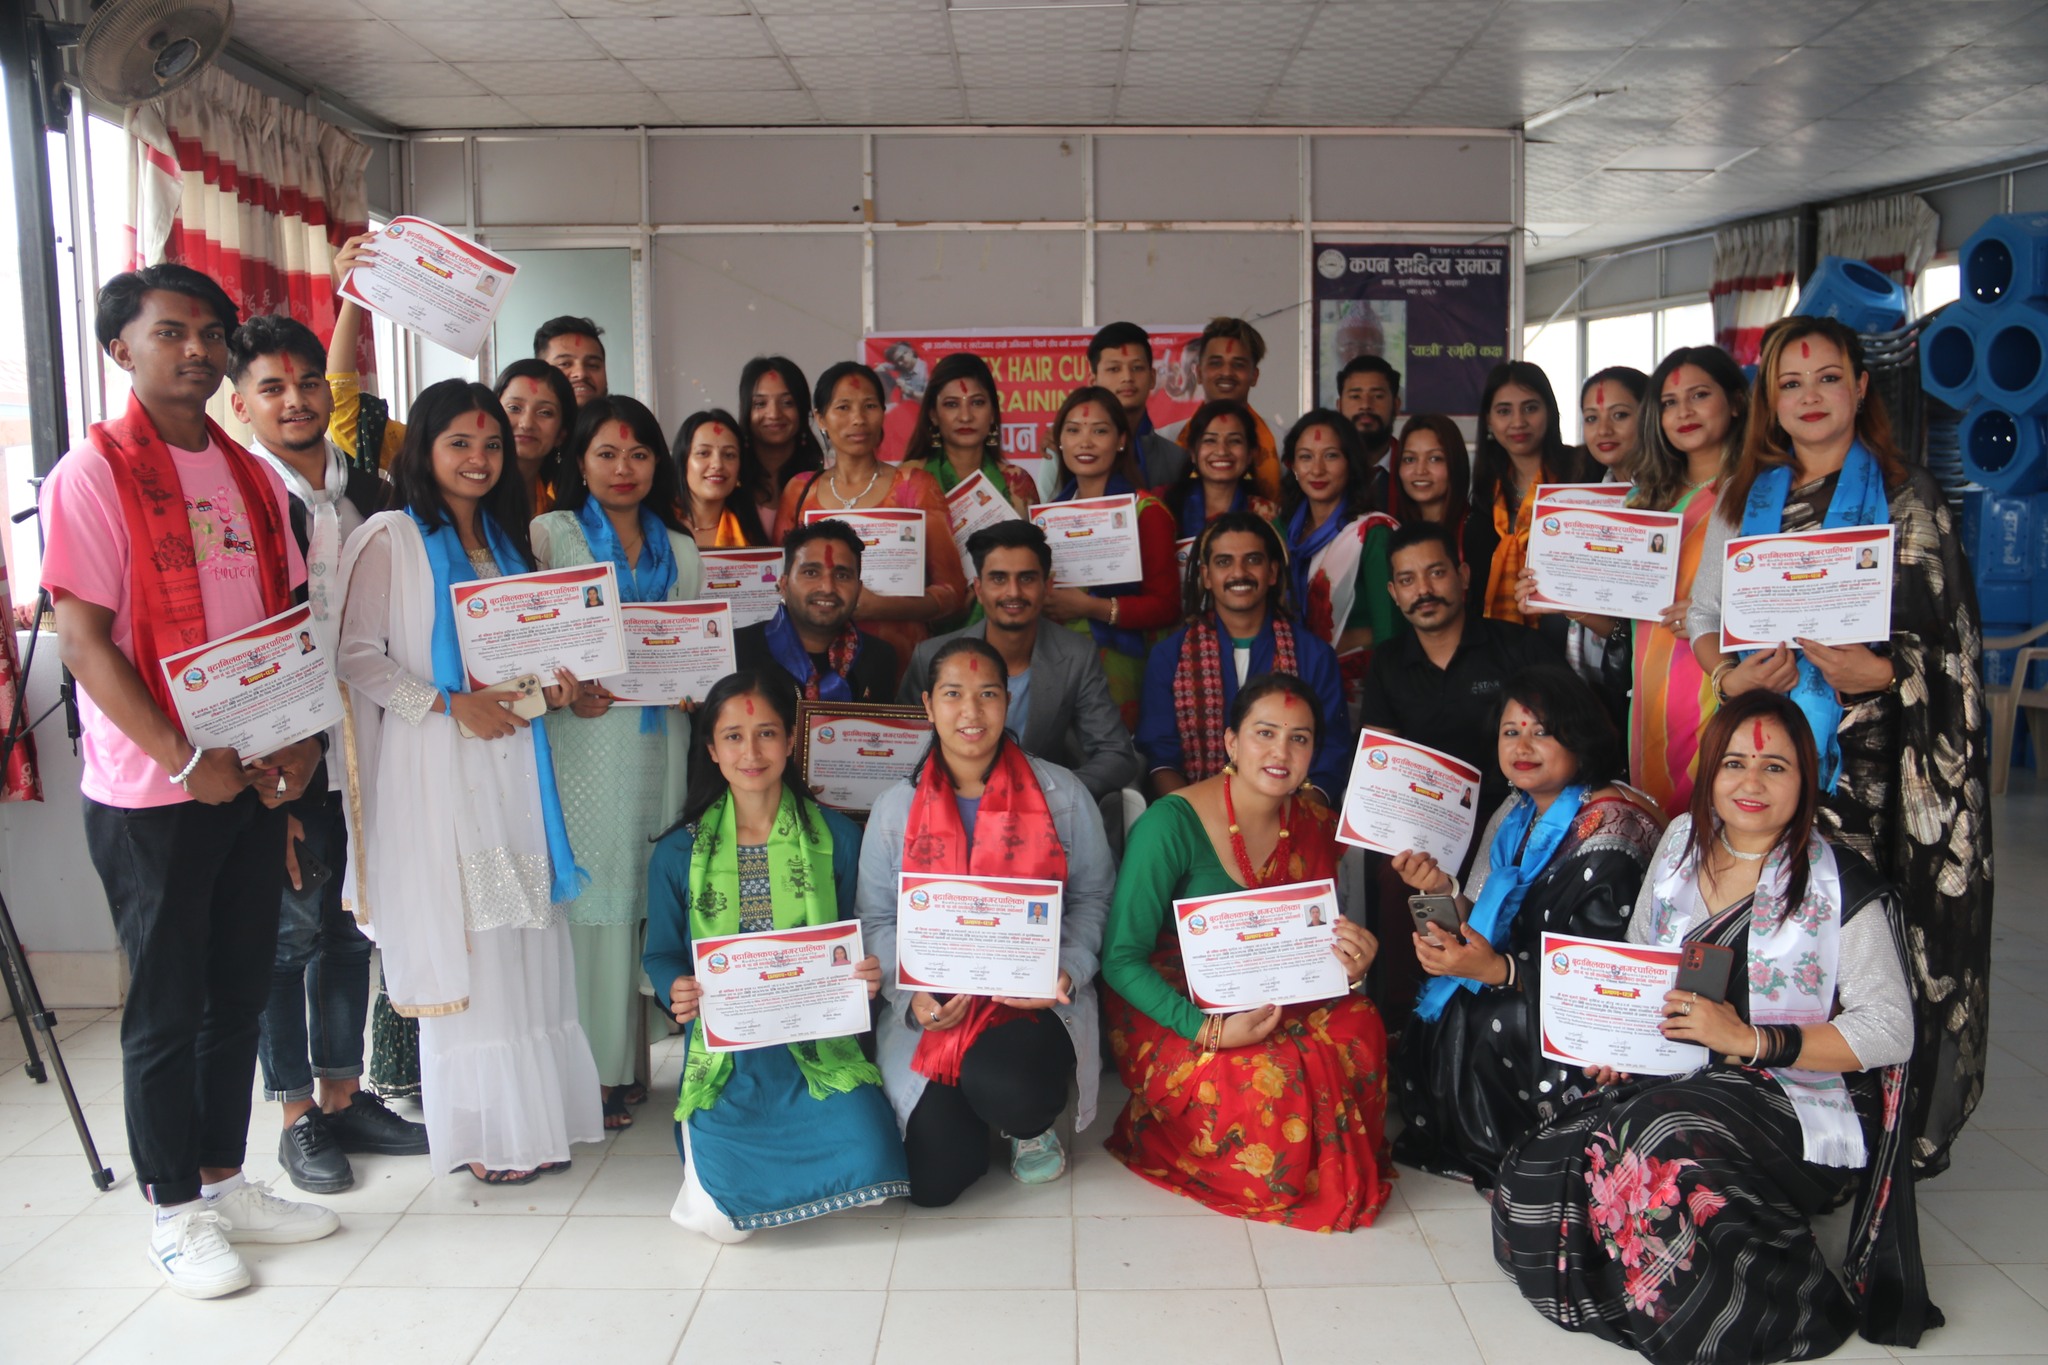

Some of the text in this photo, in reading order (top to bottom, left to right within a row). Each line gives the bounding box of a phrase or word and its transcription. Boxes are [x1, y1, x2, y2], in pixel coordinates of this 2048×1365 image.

[1349, 253, 1502, 276] कपन साहित्य समाज
[1008, 355, 1053, 382] HAIR
[1058, 354, 1088, 382] CU
